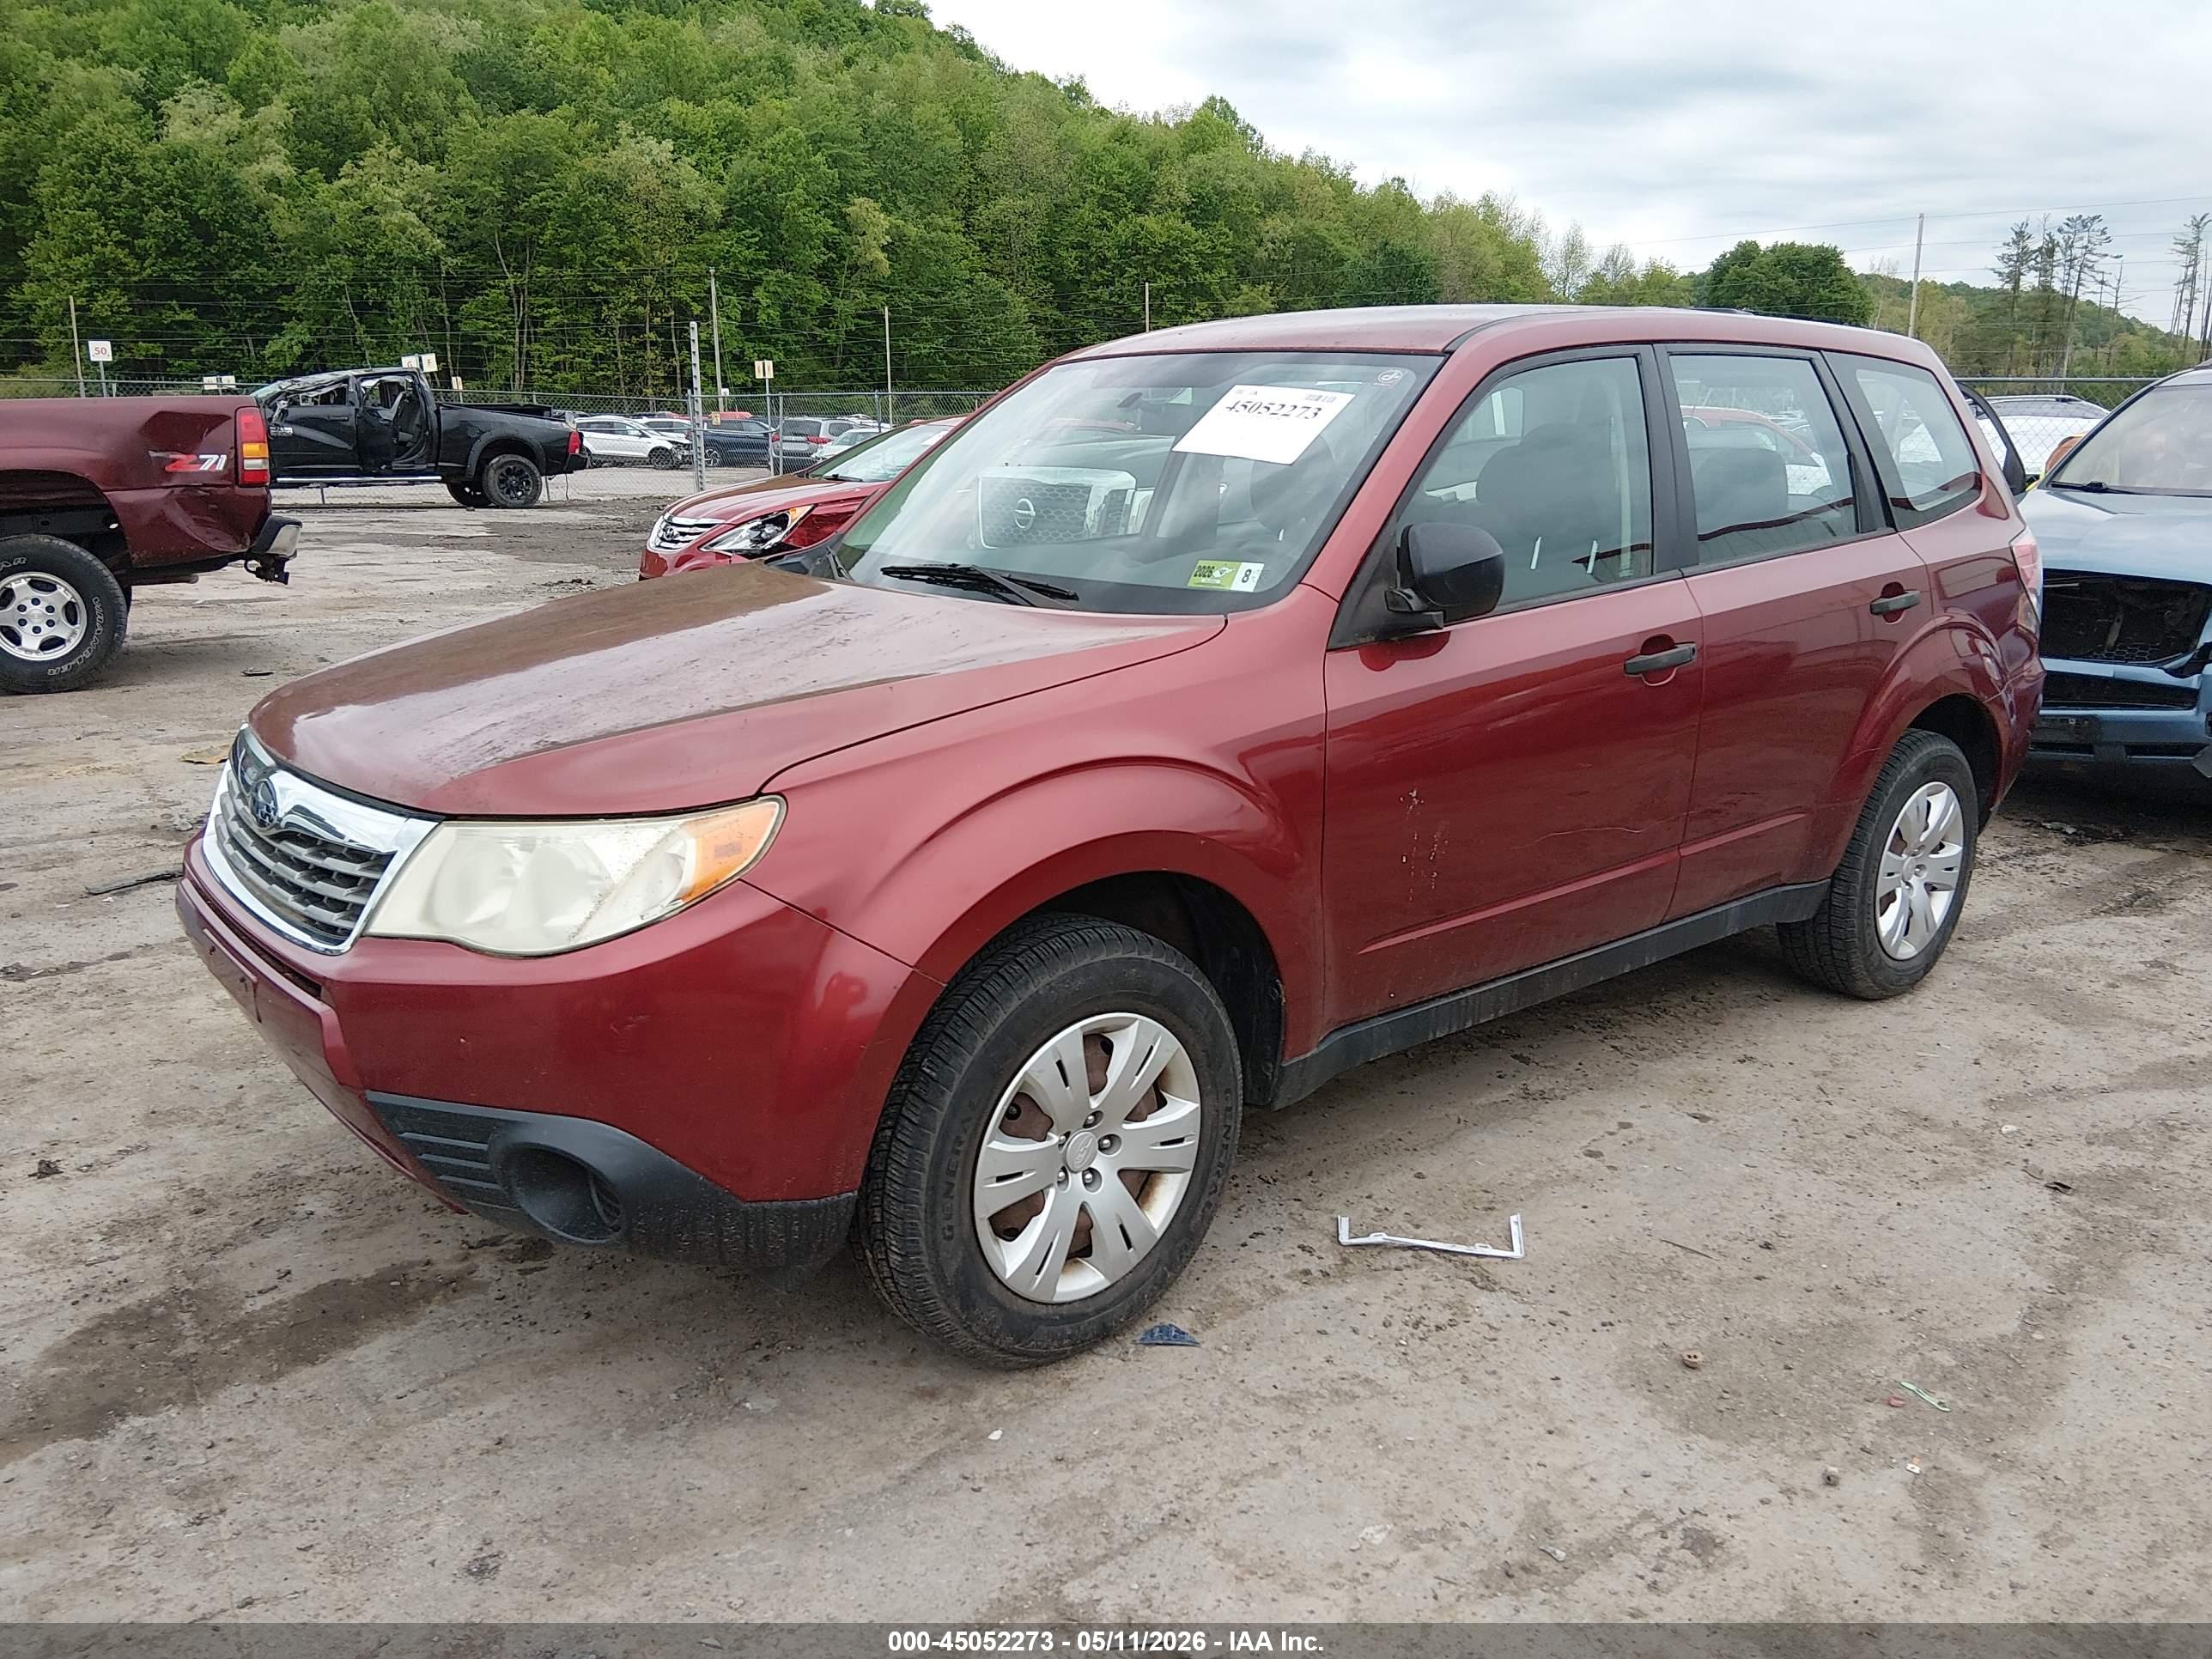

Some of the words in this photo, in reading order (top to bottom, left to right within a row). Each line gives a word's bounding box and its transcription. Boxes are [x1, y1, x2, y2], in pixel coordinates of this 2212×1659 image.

[1225, 400, 1322, 419] 45052273
[164, 453, 227, 472] Z71
[1242, 568, 1252, 583] 8
